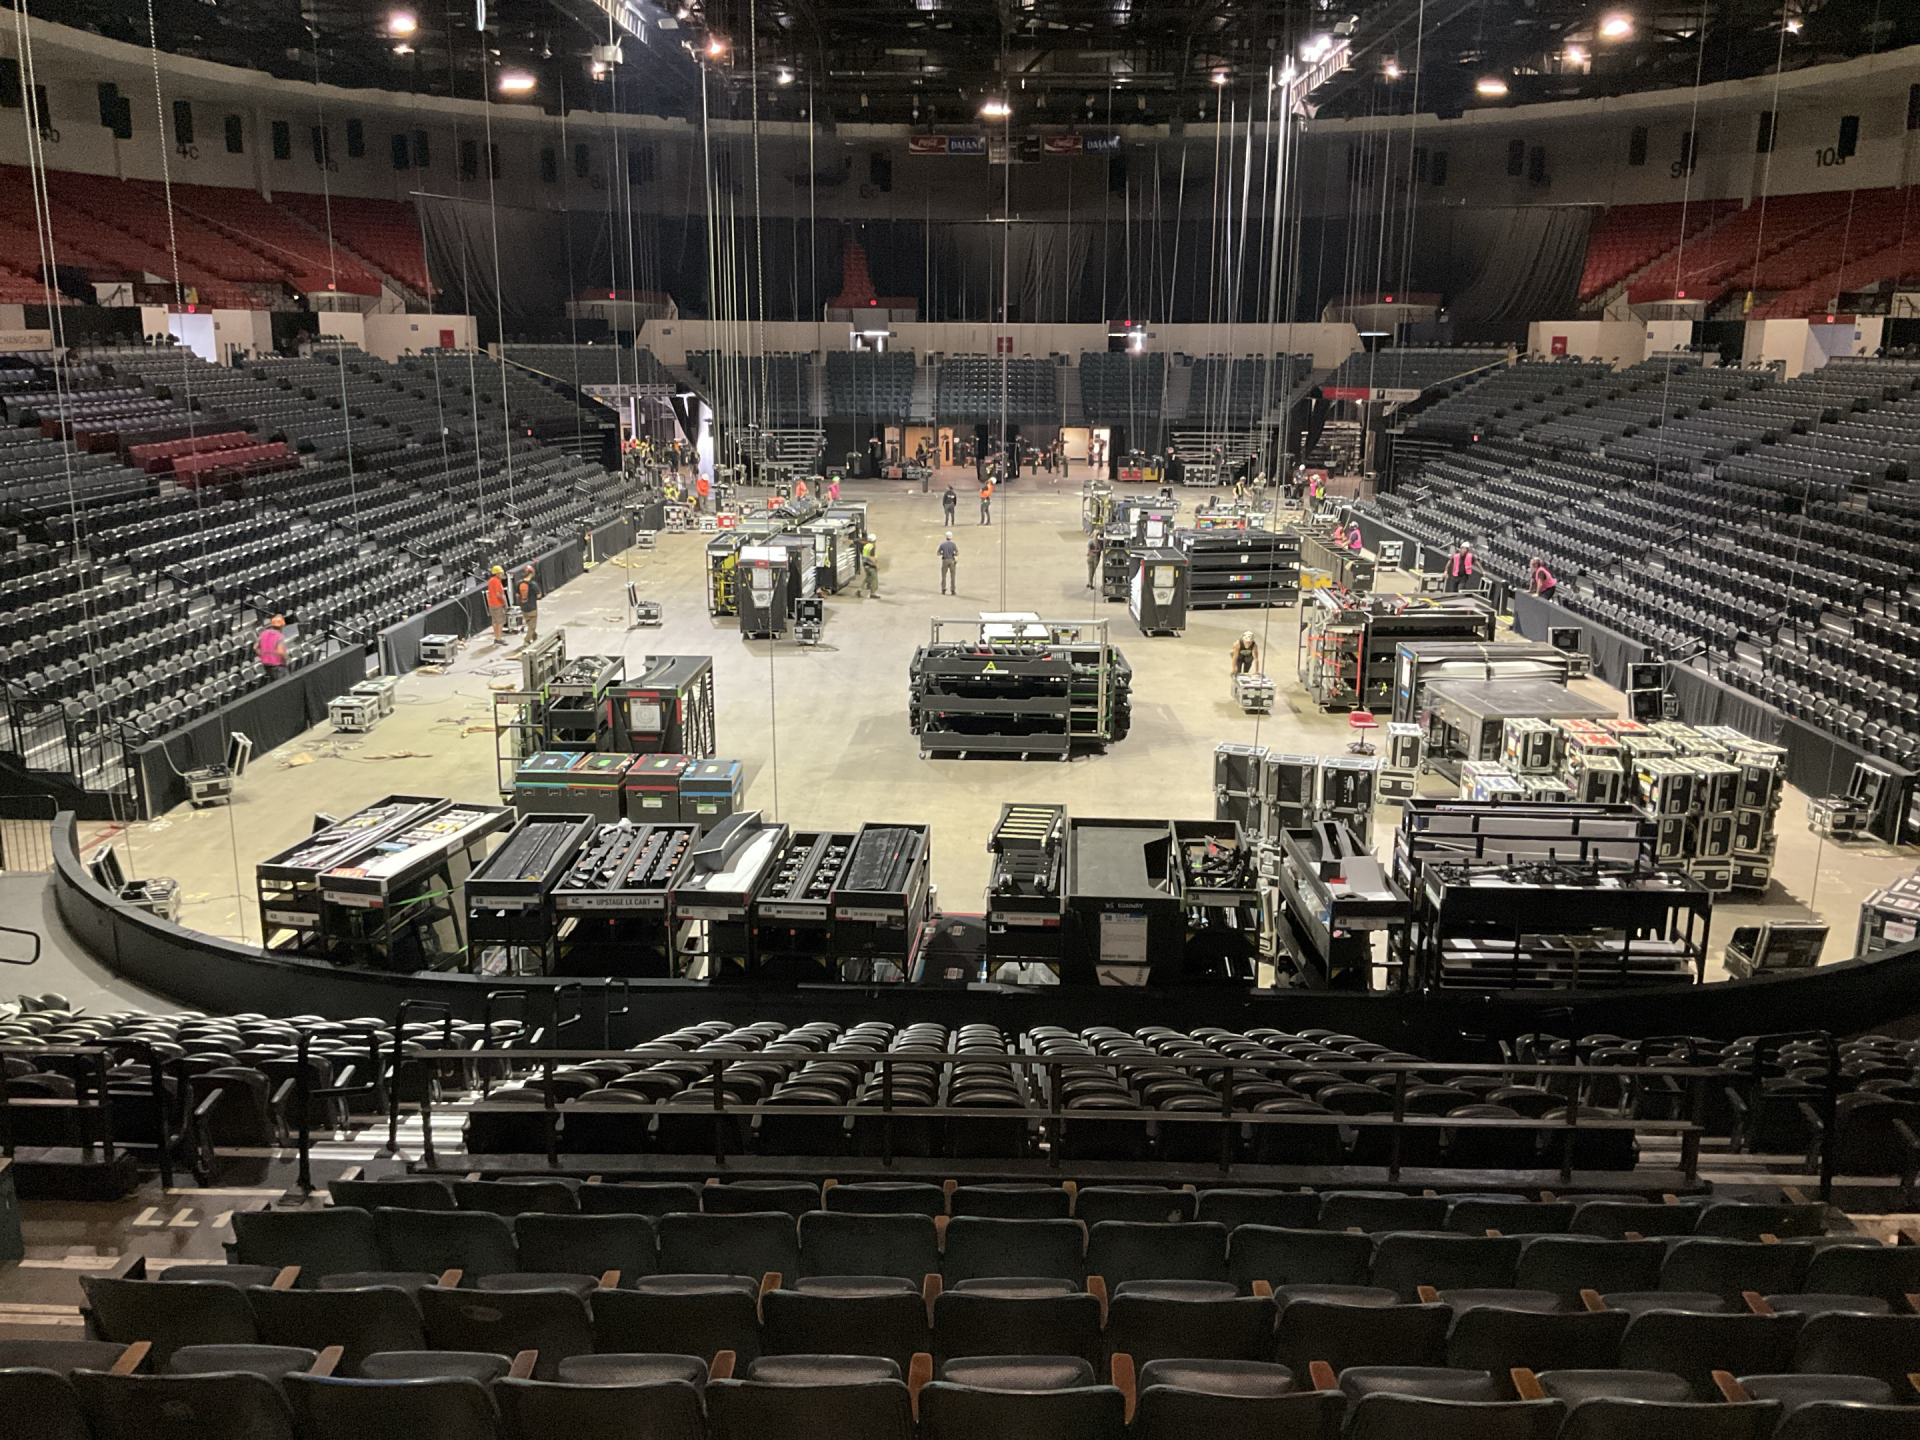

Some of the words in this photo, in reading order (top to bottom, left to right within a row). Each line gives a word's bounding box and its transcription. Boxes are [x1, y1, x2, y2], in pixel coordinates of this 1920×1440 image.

[596, 898, 624, 906] UPSTAGE
[625, 898, 633, 906] LX
[634, 898, 651, 906] CART
